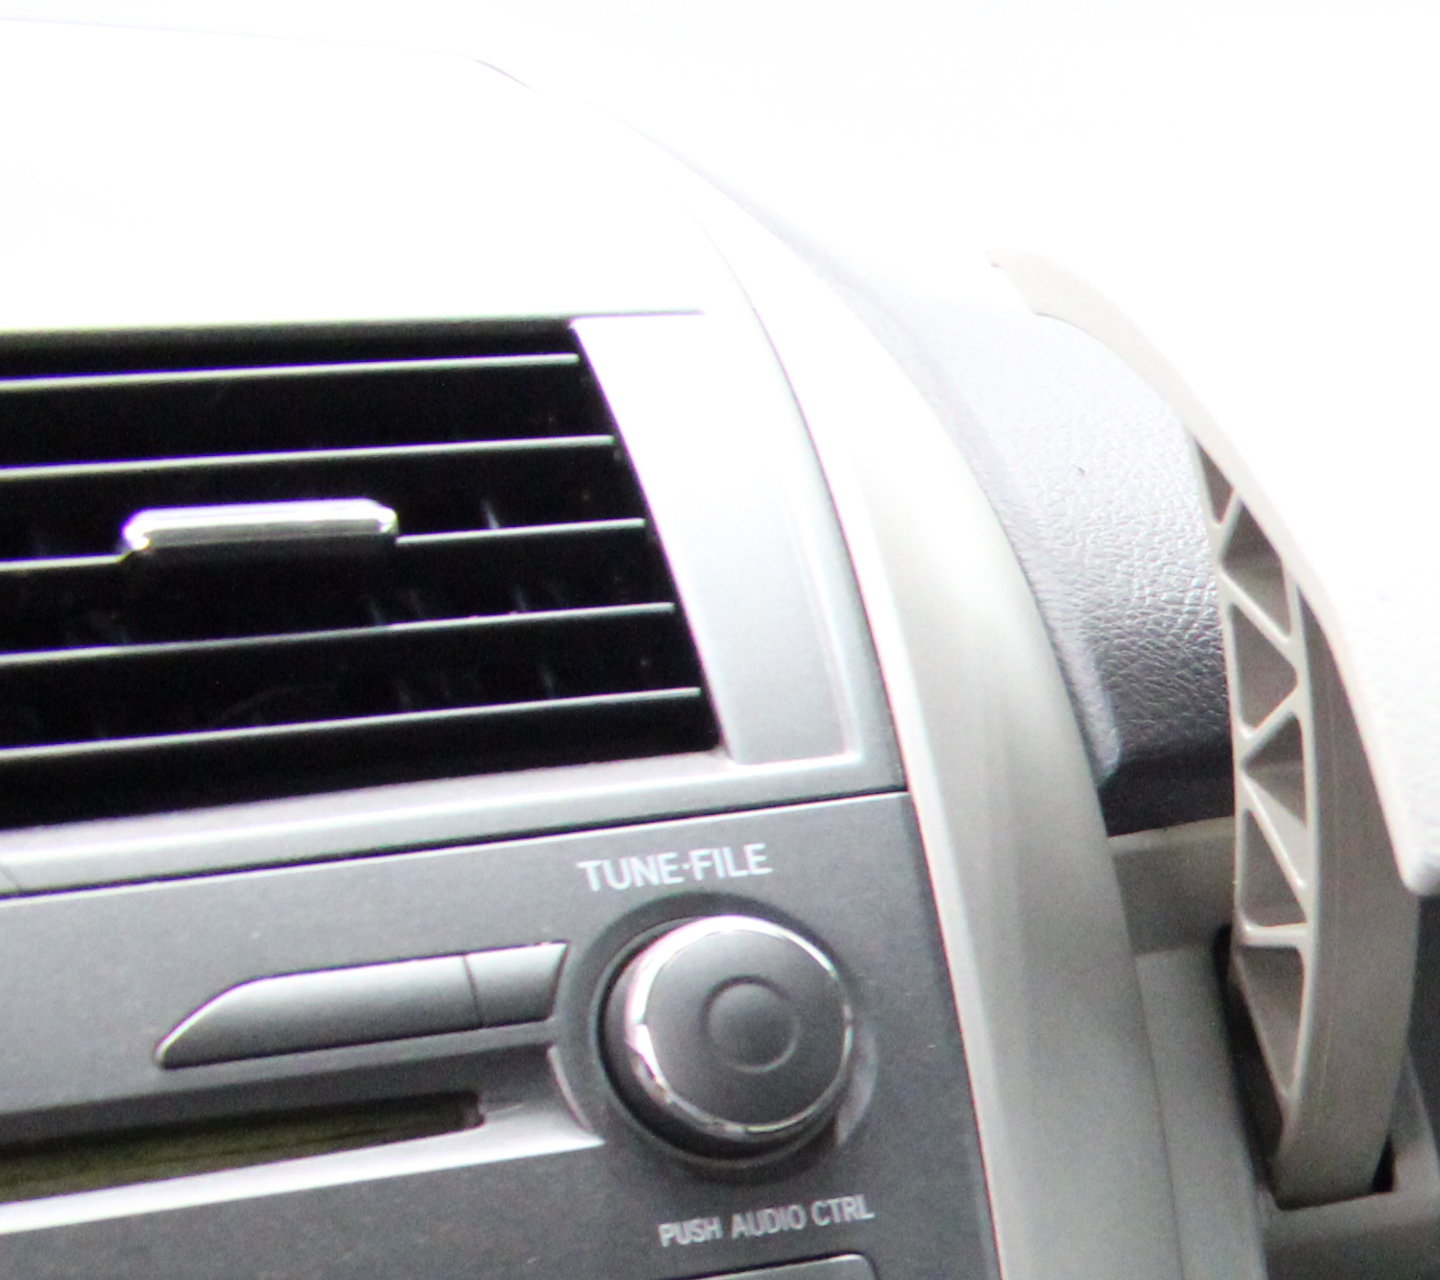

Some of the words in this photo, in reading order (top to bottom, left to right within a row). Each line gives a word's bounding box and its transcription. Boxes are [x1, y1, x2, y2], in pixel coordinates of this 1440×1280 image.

[658, 1216, 723, 1247] PUSH
[731, 1204, 807, 1240] AUDIO
[811, 1193, 876, 1226] CTRL
